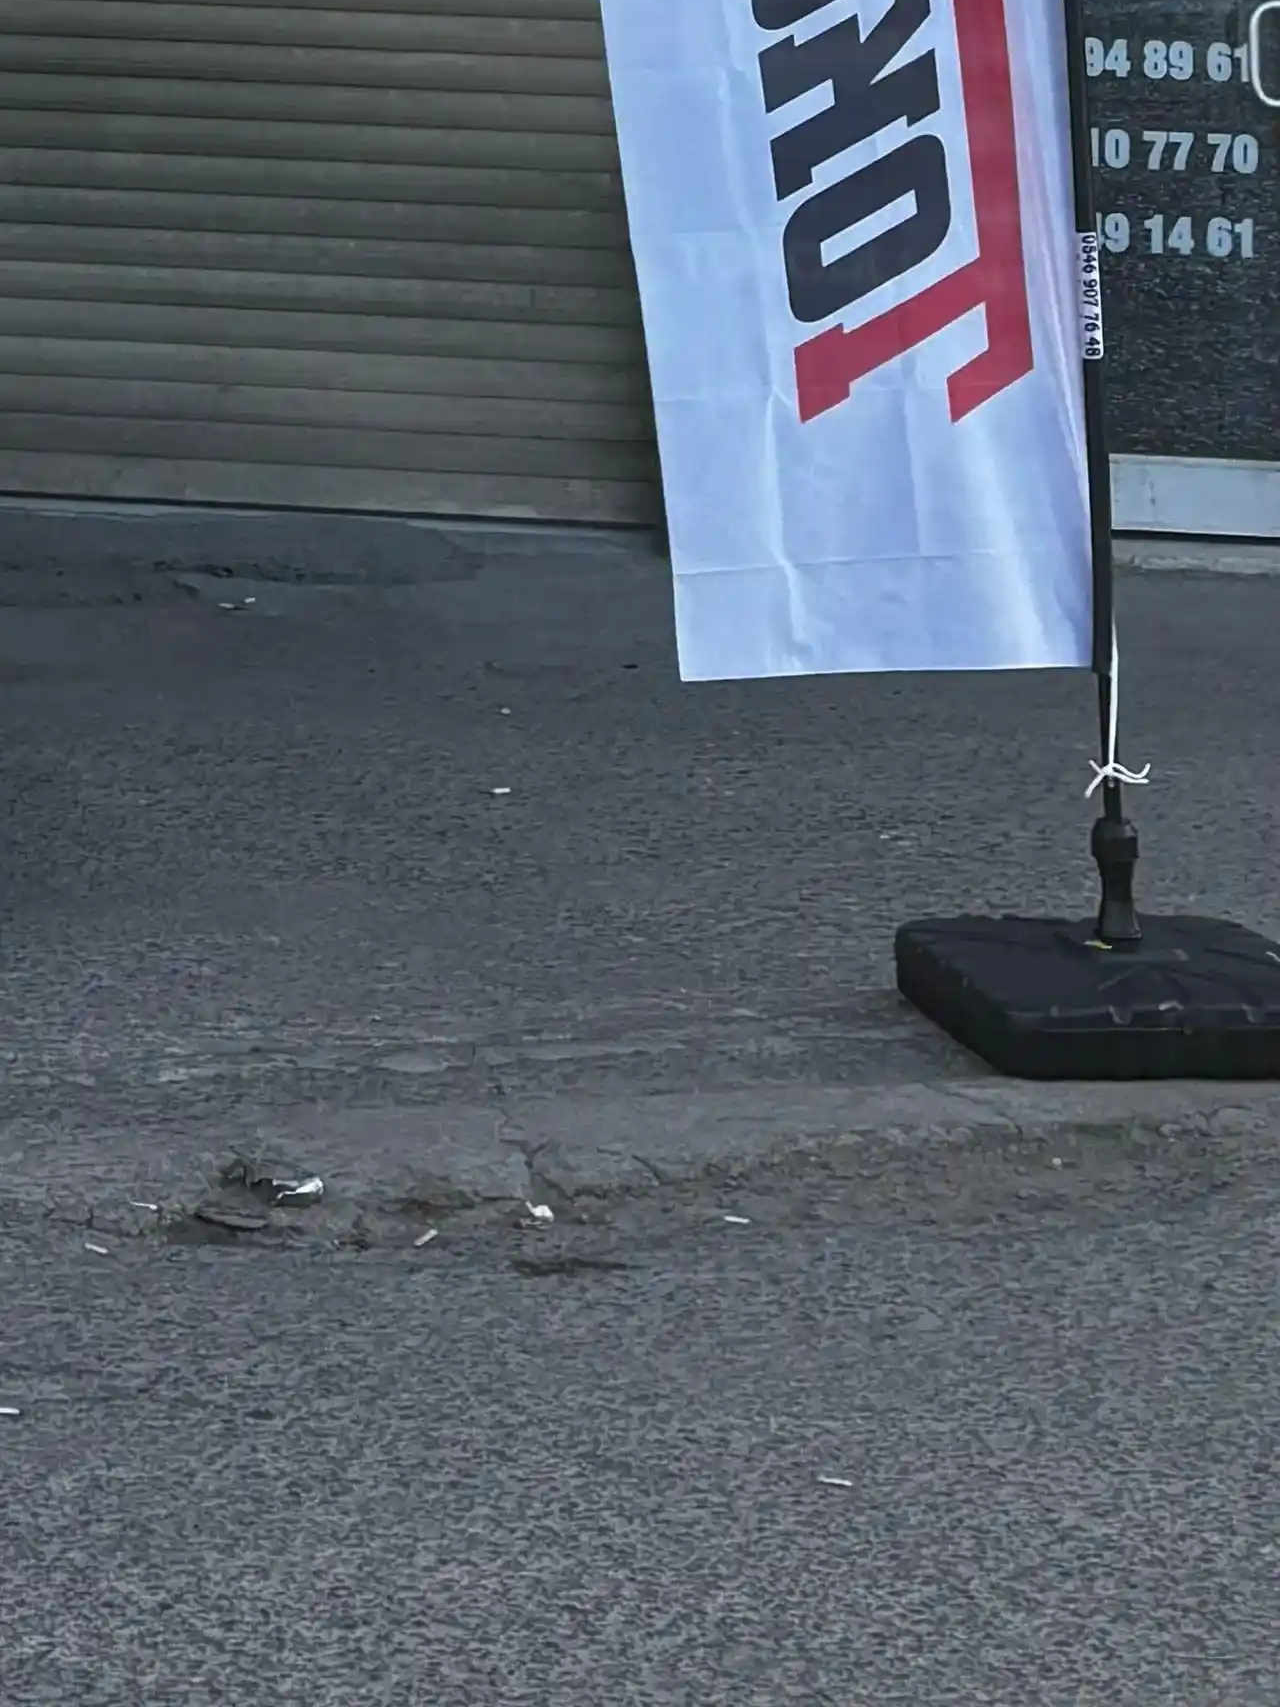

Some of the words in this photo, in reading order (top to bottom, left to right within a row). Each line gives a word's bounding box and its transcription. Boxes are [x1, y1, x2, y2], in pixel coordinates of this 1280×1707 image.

[1143, 40, 1194, 81] 89
[1143, 130, 1194, 172] 77
[1207, 133, 1259, 175] 70
[1081, 234, 1097, 274] 0546
[1144, 214, 1195, 256] 14
[1206, 216, 1255, 259] 61
[1082, 279, 1099, 308] 907
[1083, 313, 1101, 333] 76
